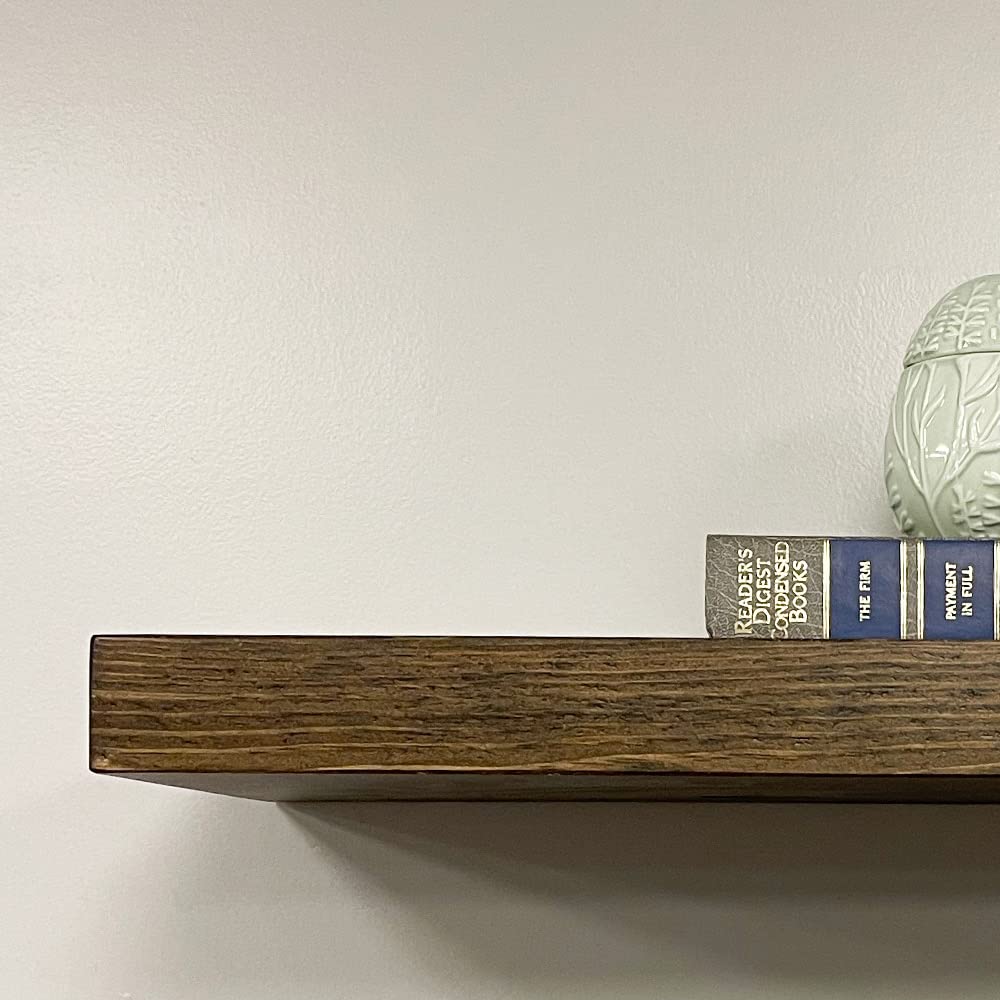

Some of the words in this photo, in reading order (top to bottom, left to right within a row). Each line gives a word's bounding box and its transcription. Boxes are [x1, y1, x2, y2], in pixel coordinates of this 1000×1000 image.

[735, 548, 753, 634] READER'S
[753, 557, 771, 625] DIGEST
[789, 560, 808, 623] BOOKS
[859, 560, 871, 591] FIRM
[945, 562, 957, 620] PAYMENT
[961, 565, 974, 598] FULL
[859, 595, 871, 622] THE
[961, 602, 973, 617] IN
